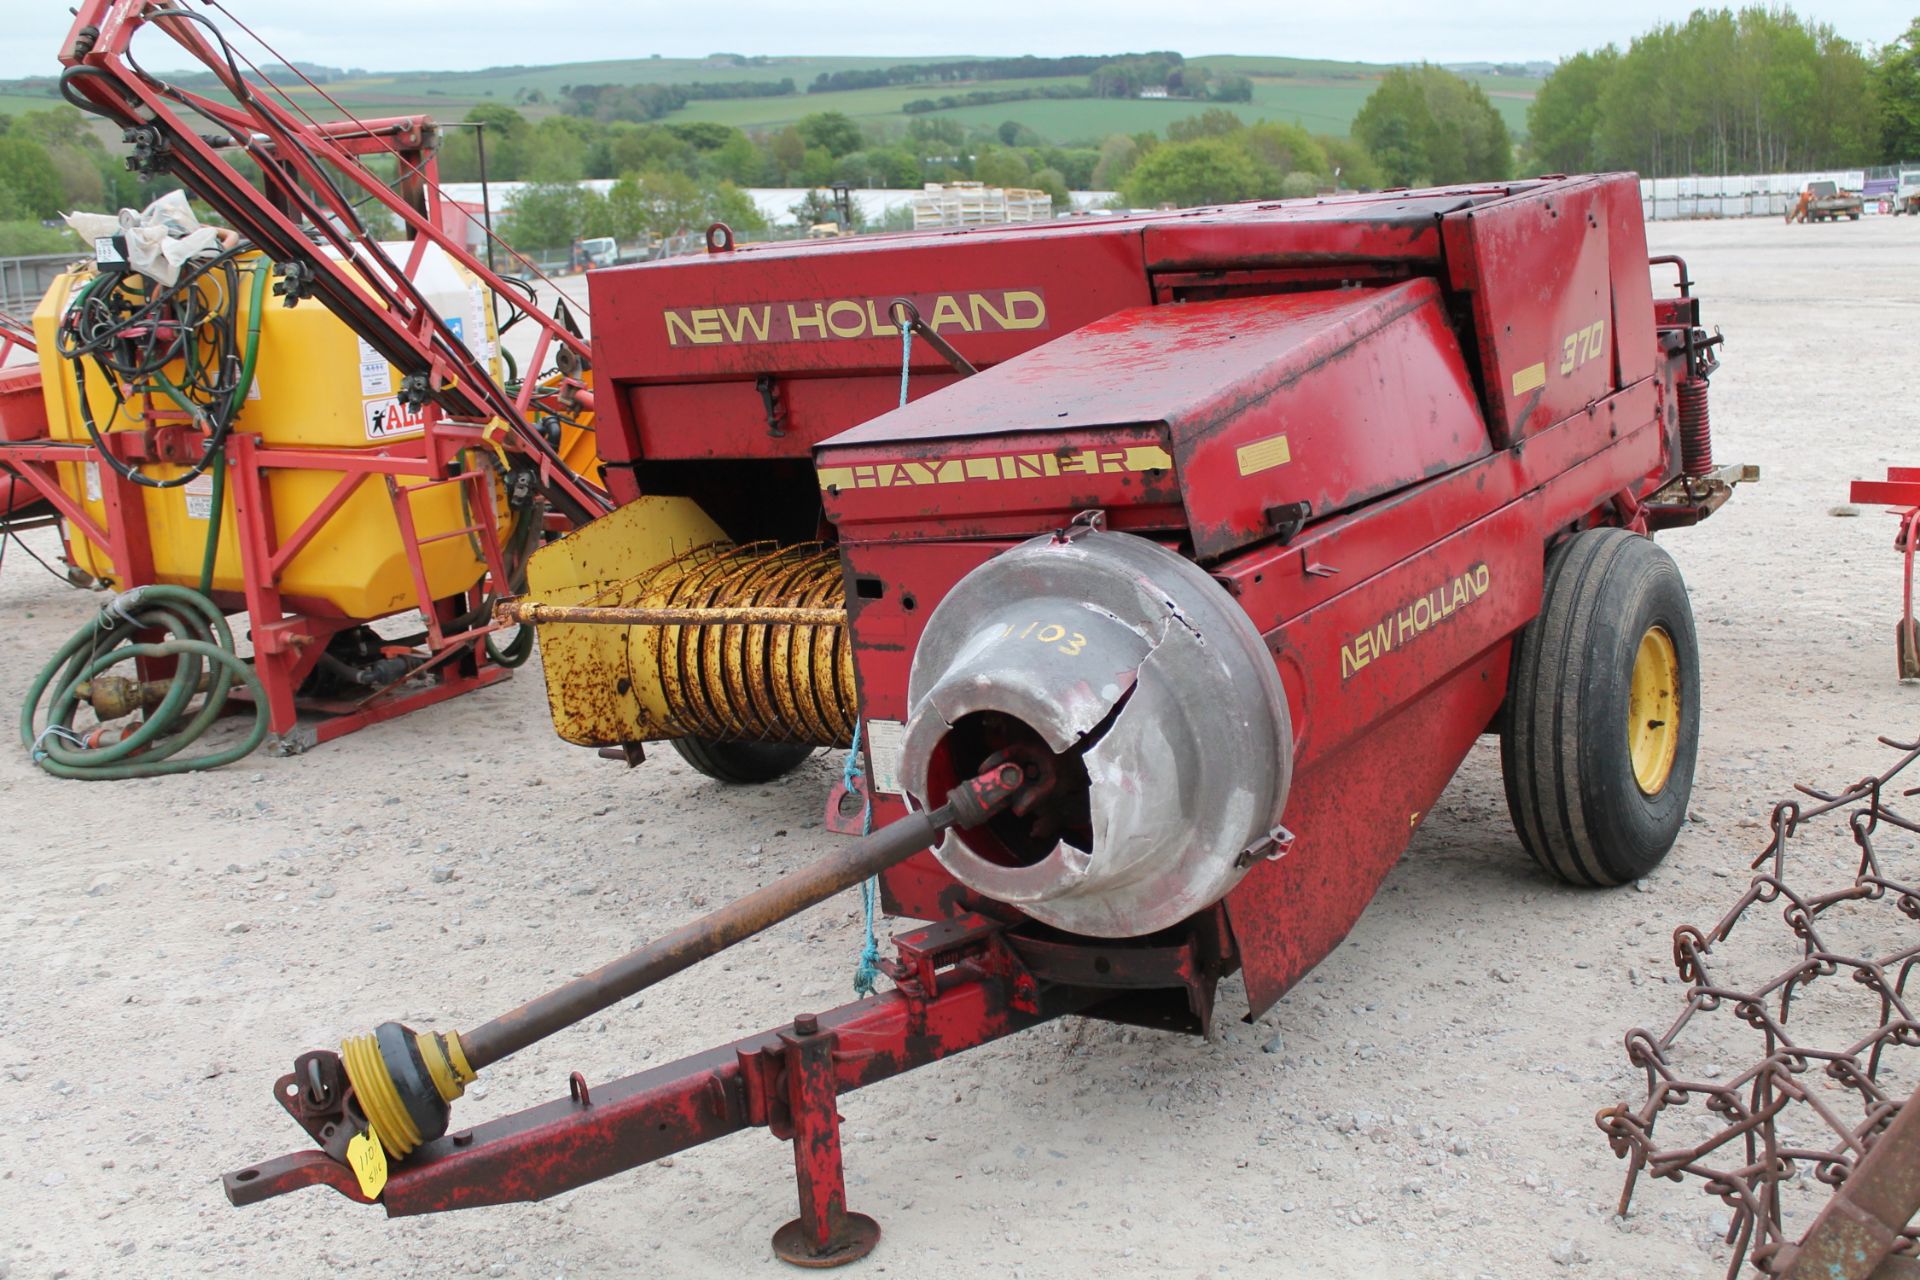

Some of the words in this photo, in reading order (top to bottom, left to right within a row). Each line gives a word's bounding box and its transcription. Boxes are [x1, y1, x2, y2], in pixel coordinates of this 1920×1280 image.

[664, 305, 771, 345] NEW
[787, 290, 1046, 340] HOLLAND
[1560, 319, 1604, 375] 370
[852, 449, 1130, 489] HAYLINER
[1003, 621, 1088, 656] 1103
[1341, 617, 1393, 679] NEW
[1397, 563, 1490, 643] HOLLAND
